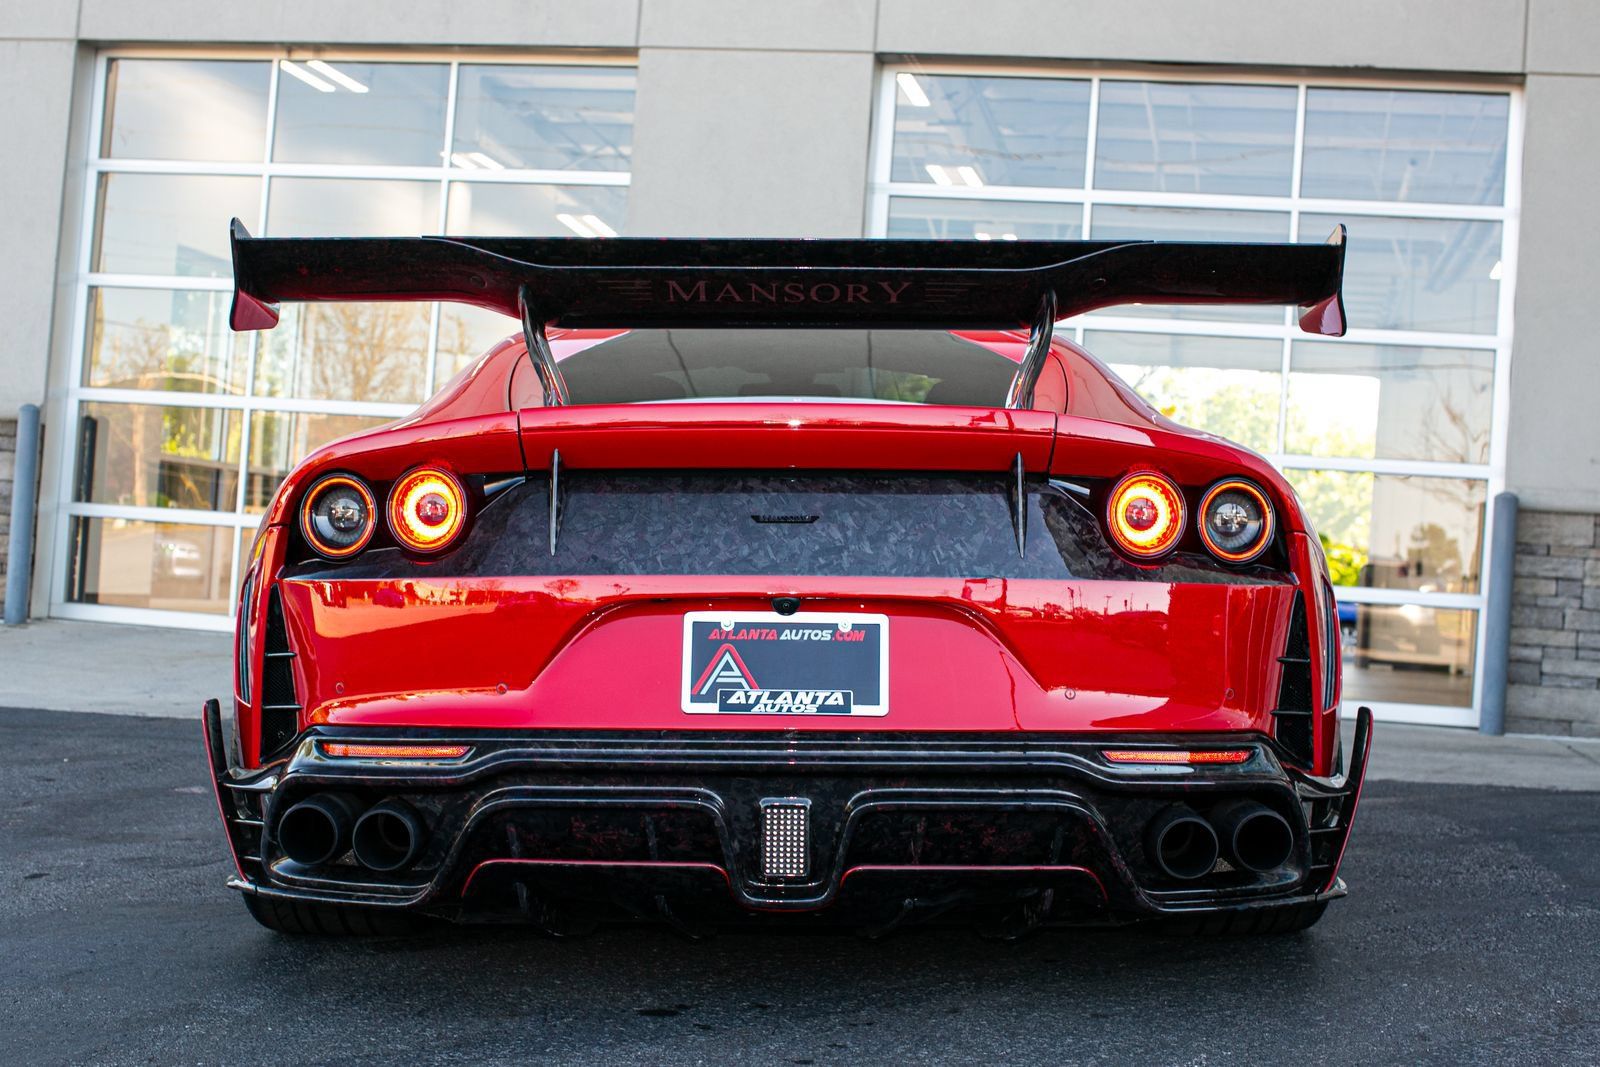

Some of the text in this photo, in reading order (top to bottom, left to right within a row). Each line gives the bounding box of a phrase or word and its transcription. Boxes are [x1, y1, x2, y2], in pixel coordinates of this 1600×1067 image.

[666, 280, 912, 304] MANSORY
[708, 629, 778, 641] ATLANTA
[726, 691, 845, 705] ATLANTA
[750, 703, 818, 713] AUTOS
